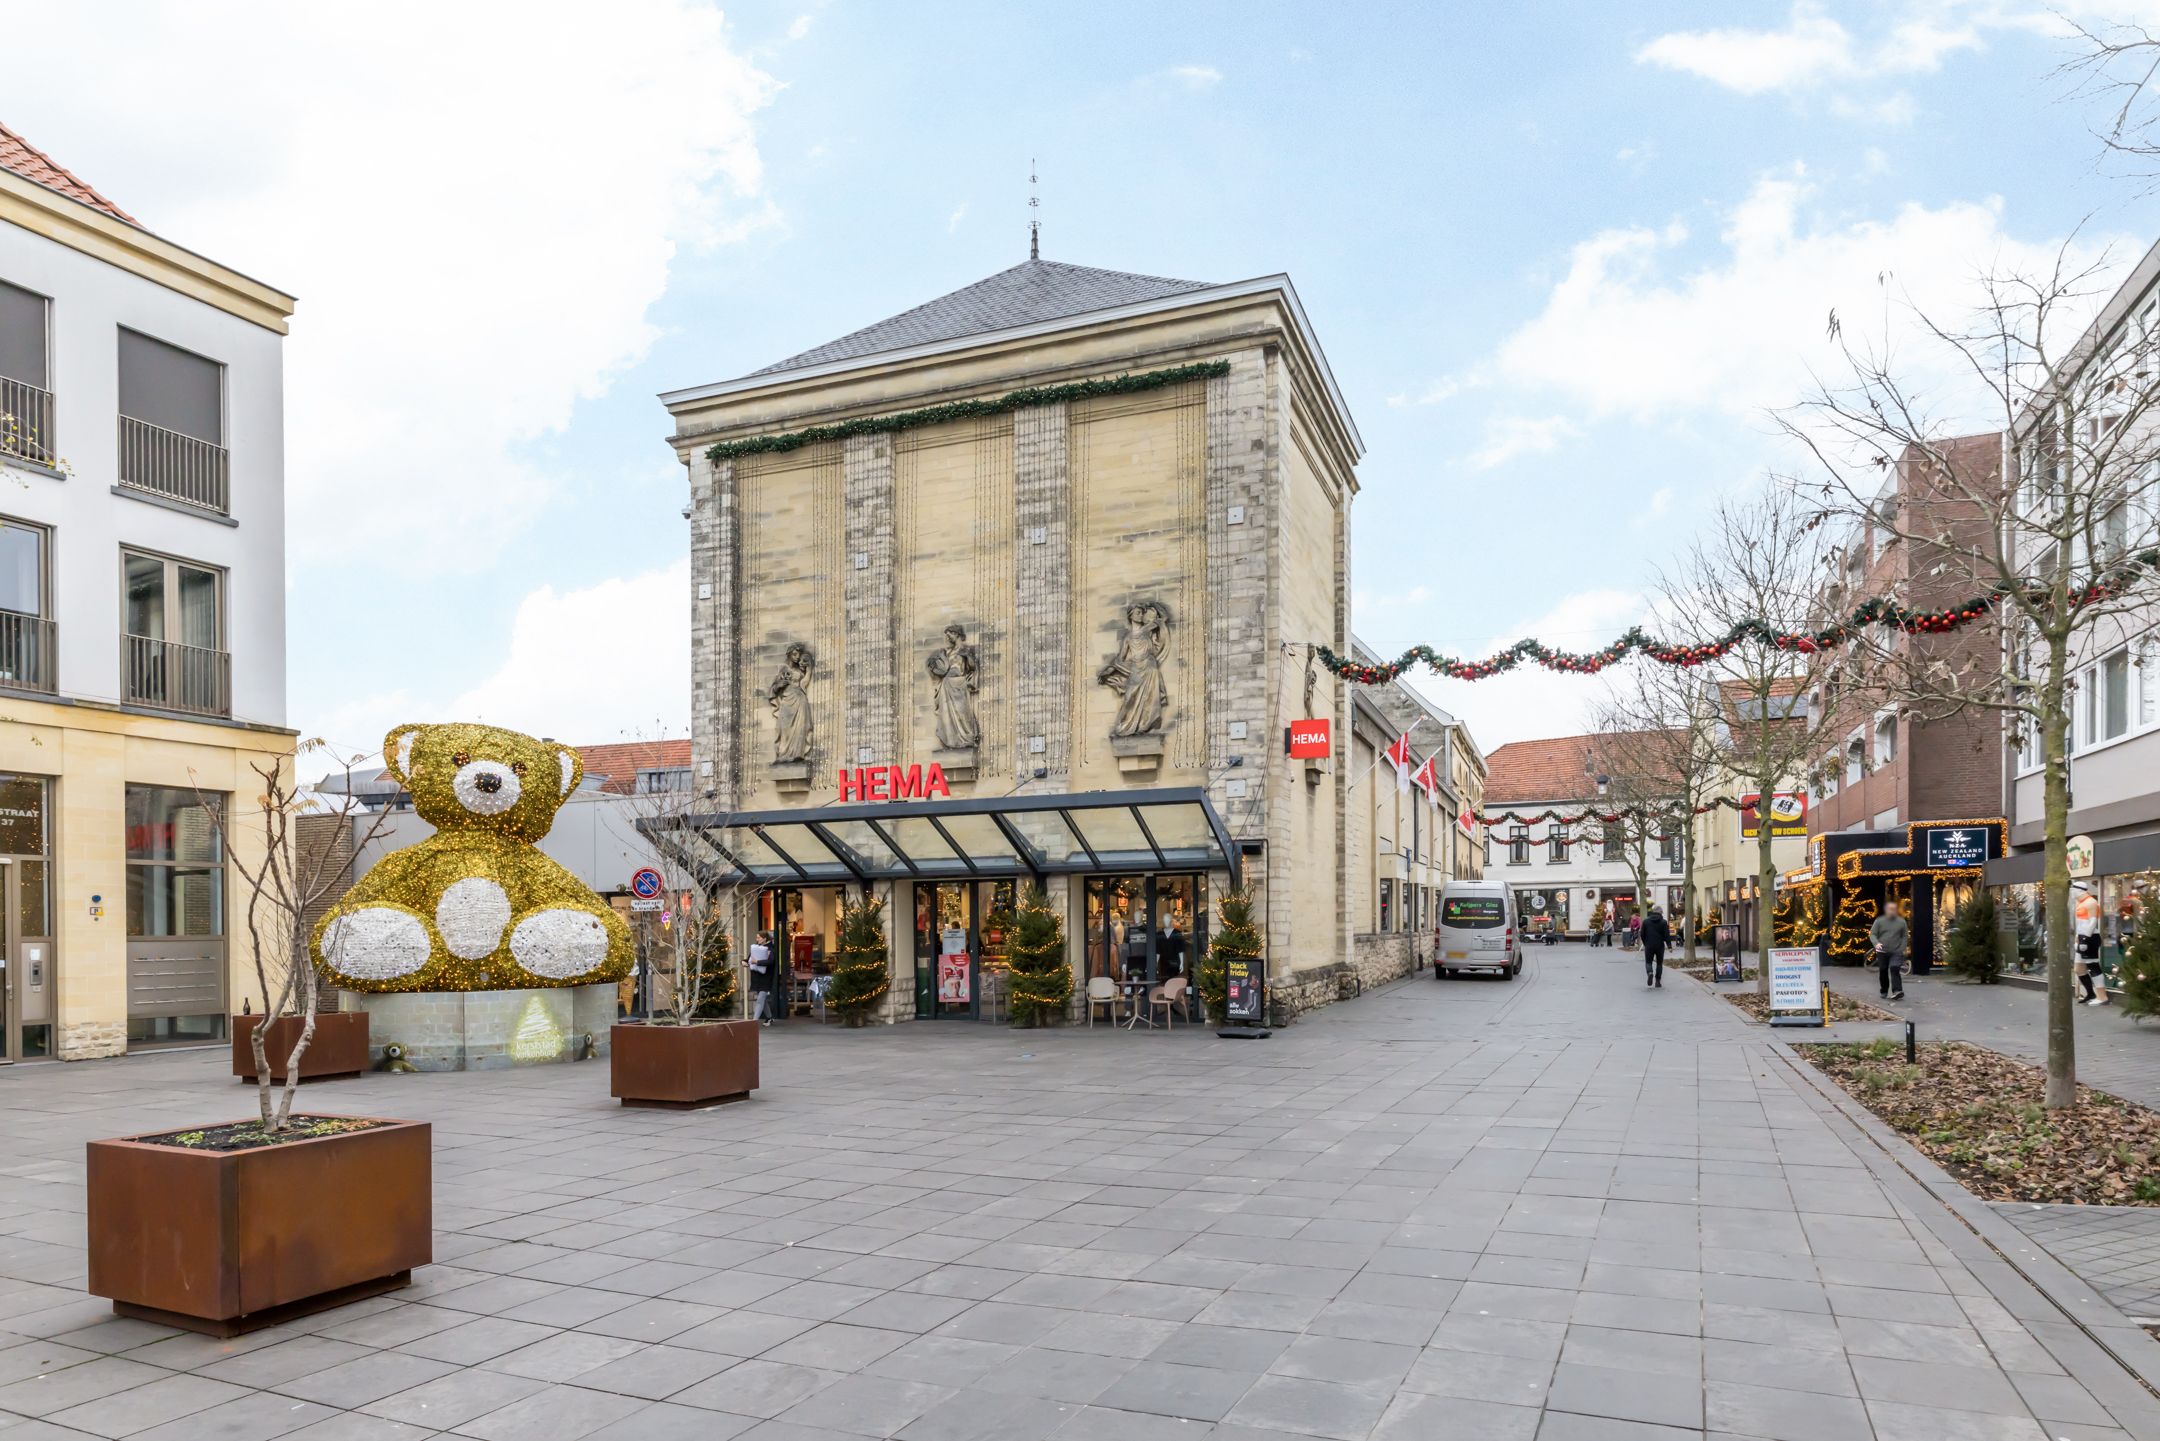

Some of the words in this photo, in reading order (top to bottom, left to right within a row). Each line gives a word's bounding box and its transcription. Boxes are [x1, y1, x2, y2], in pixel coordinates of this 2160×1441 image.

[1292, 732, 1327, 745] HEMA
[839, 763, 951, 802] HEMA
[1, 818, 14, 826] 37
[1229, 961, 1247, 969] black
